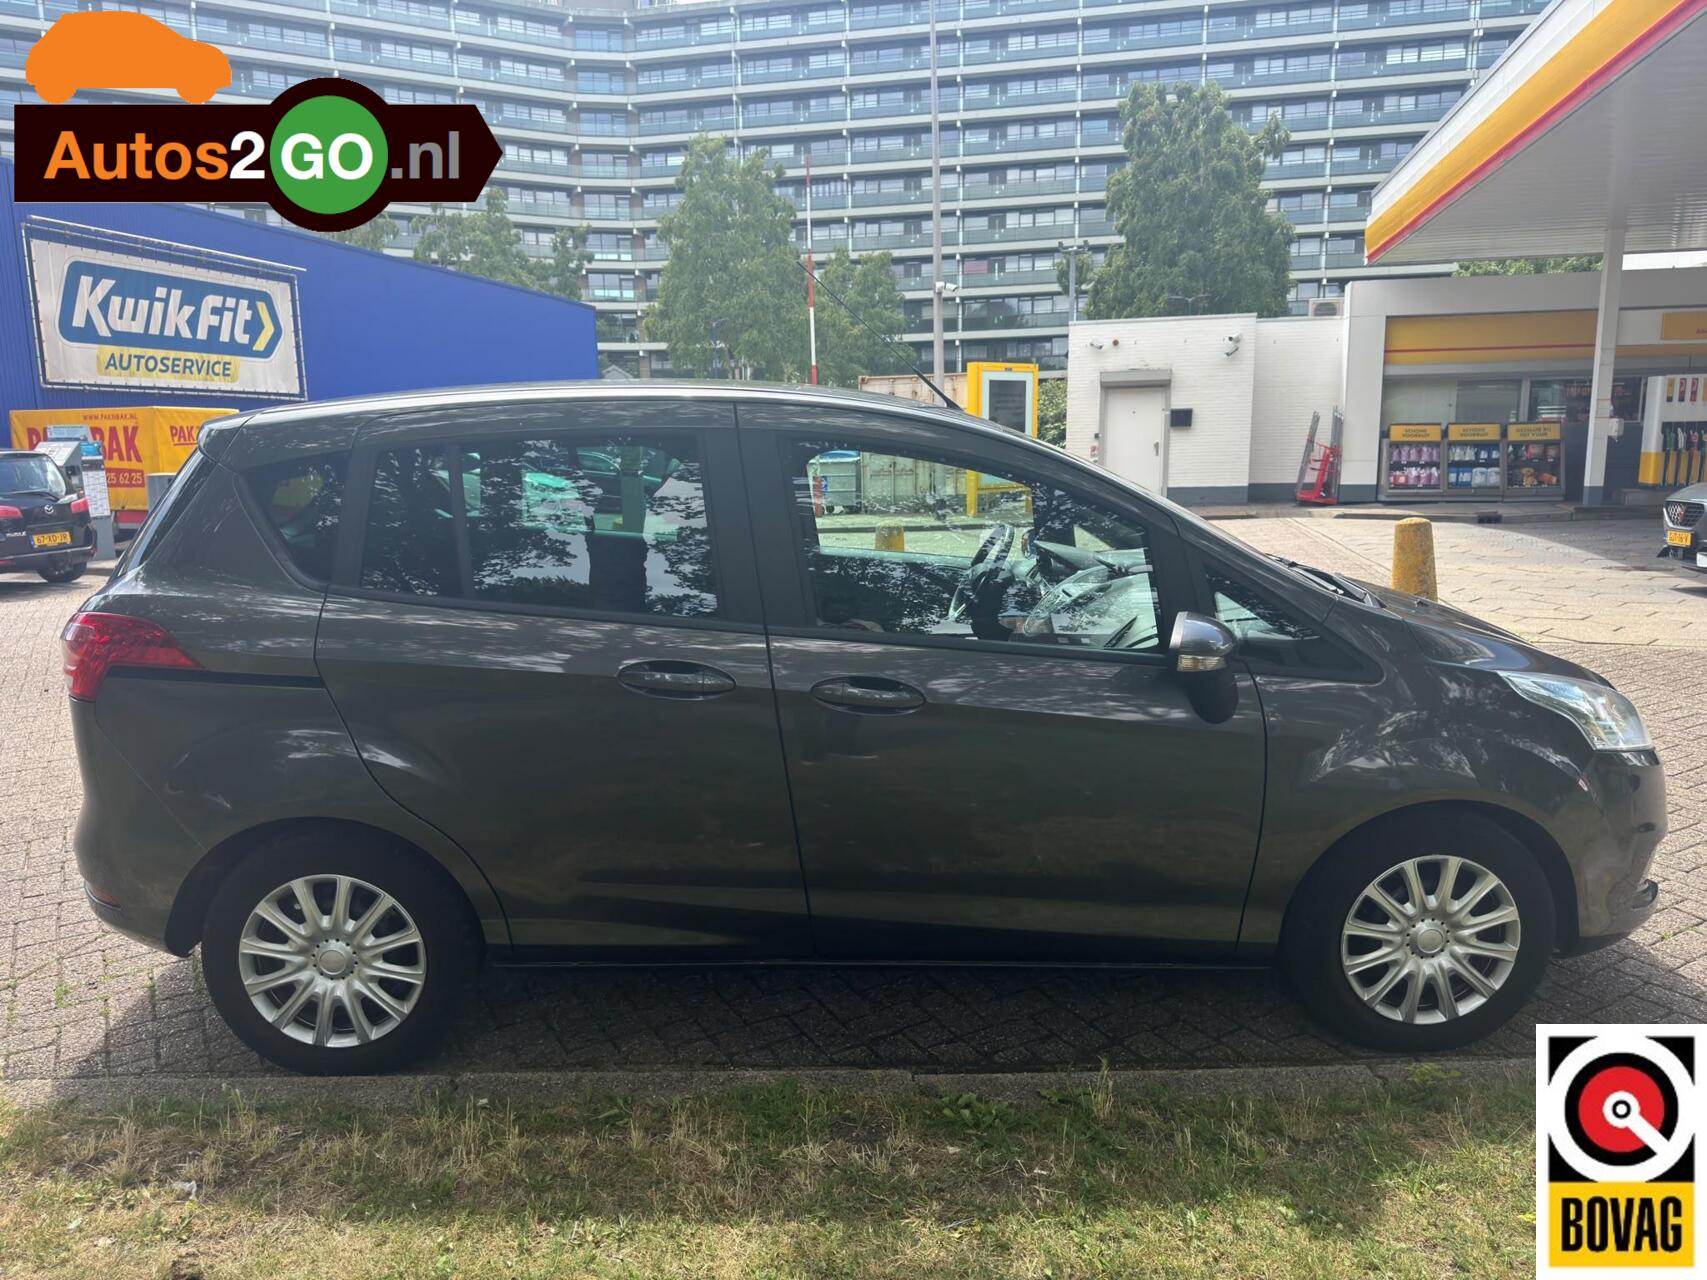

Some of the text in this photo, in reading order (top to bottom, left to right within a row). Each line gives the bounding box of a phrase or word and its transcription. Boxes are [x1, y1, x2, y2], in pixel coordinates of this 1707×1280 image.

[104, 352, 232, 378] AUTOSERVICE
[169, 425, 196, 442] PAK
[119, 472, 130, 484] 62
[132, 473, 143, 485] 25
